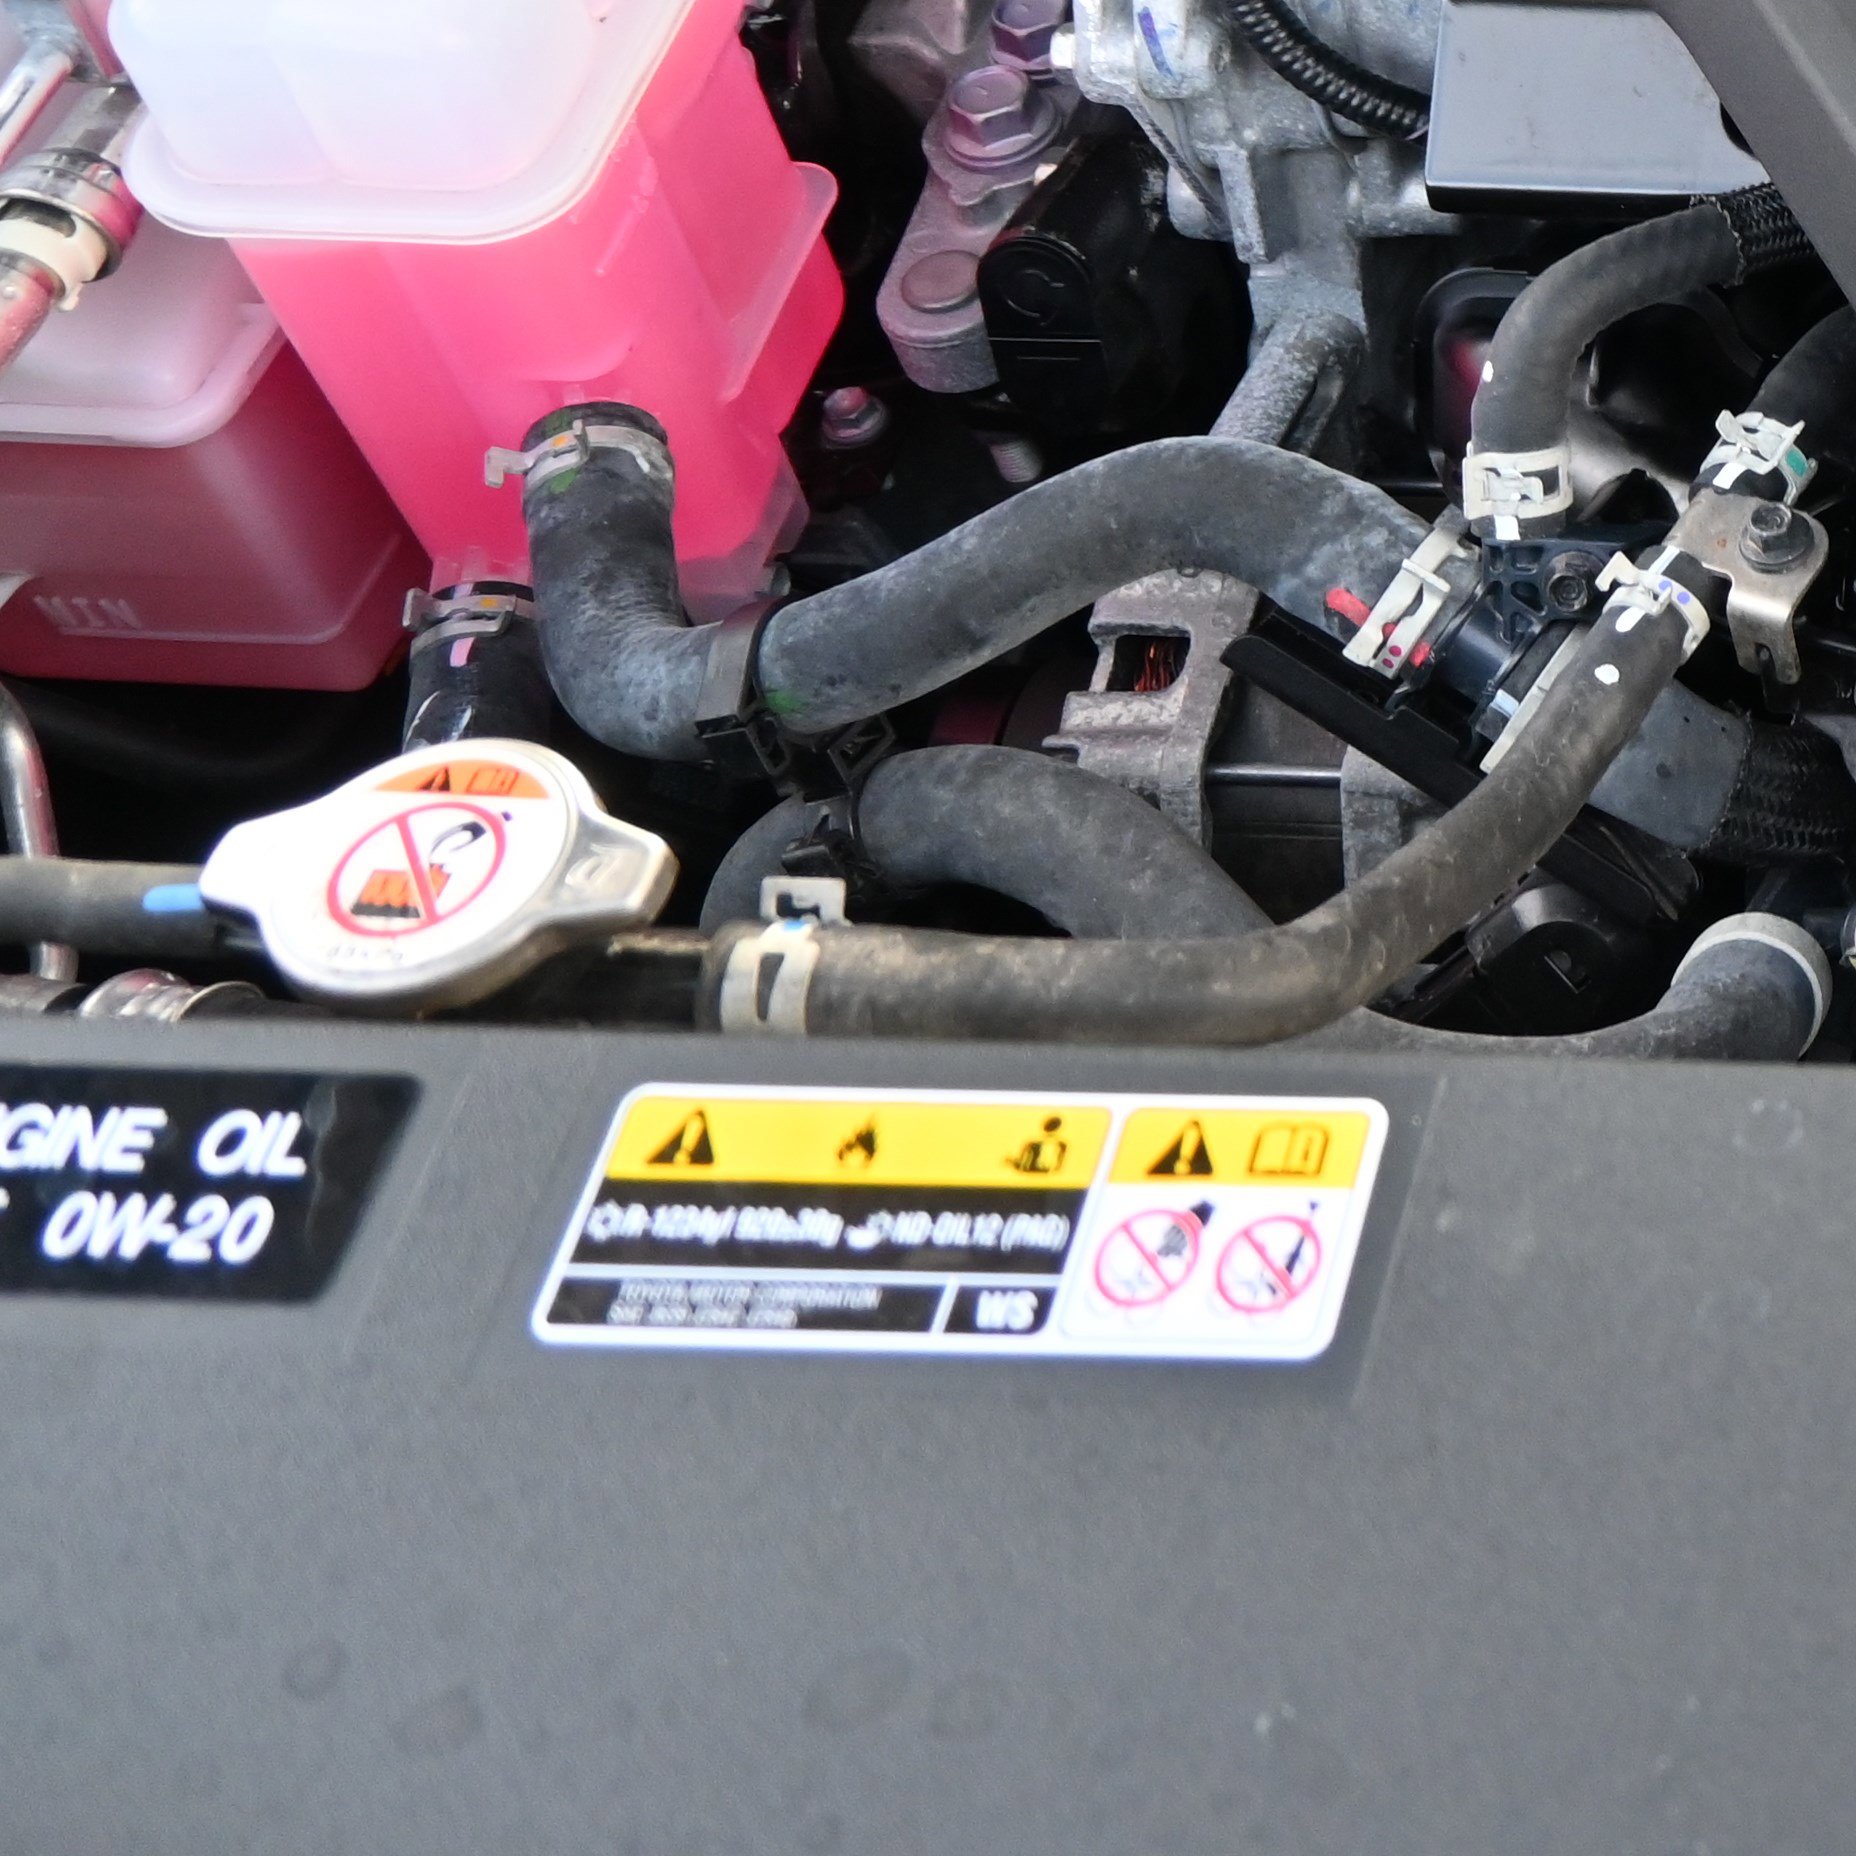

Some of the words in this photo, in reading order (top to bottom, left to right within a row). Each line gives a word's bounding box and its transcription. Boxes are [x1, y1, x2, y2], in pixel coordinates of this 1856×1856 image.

[33, 595, 142, 629] MIN
[0, 1102, 168, 1173] GINE
[196, 1108, 307, 1177] OIL
[41, 1190, 274, 1265] 0W-20
[974, 1290, 1038, 1331] WS
